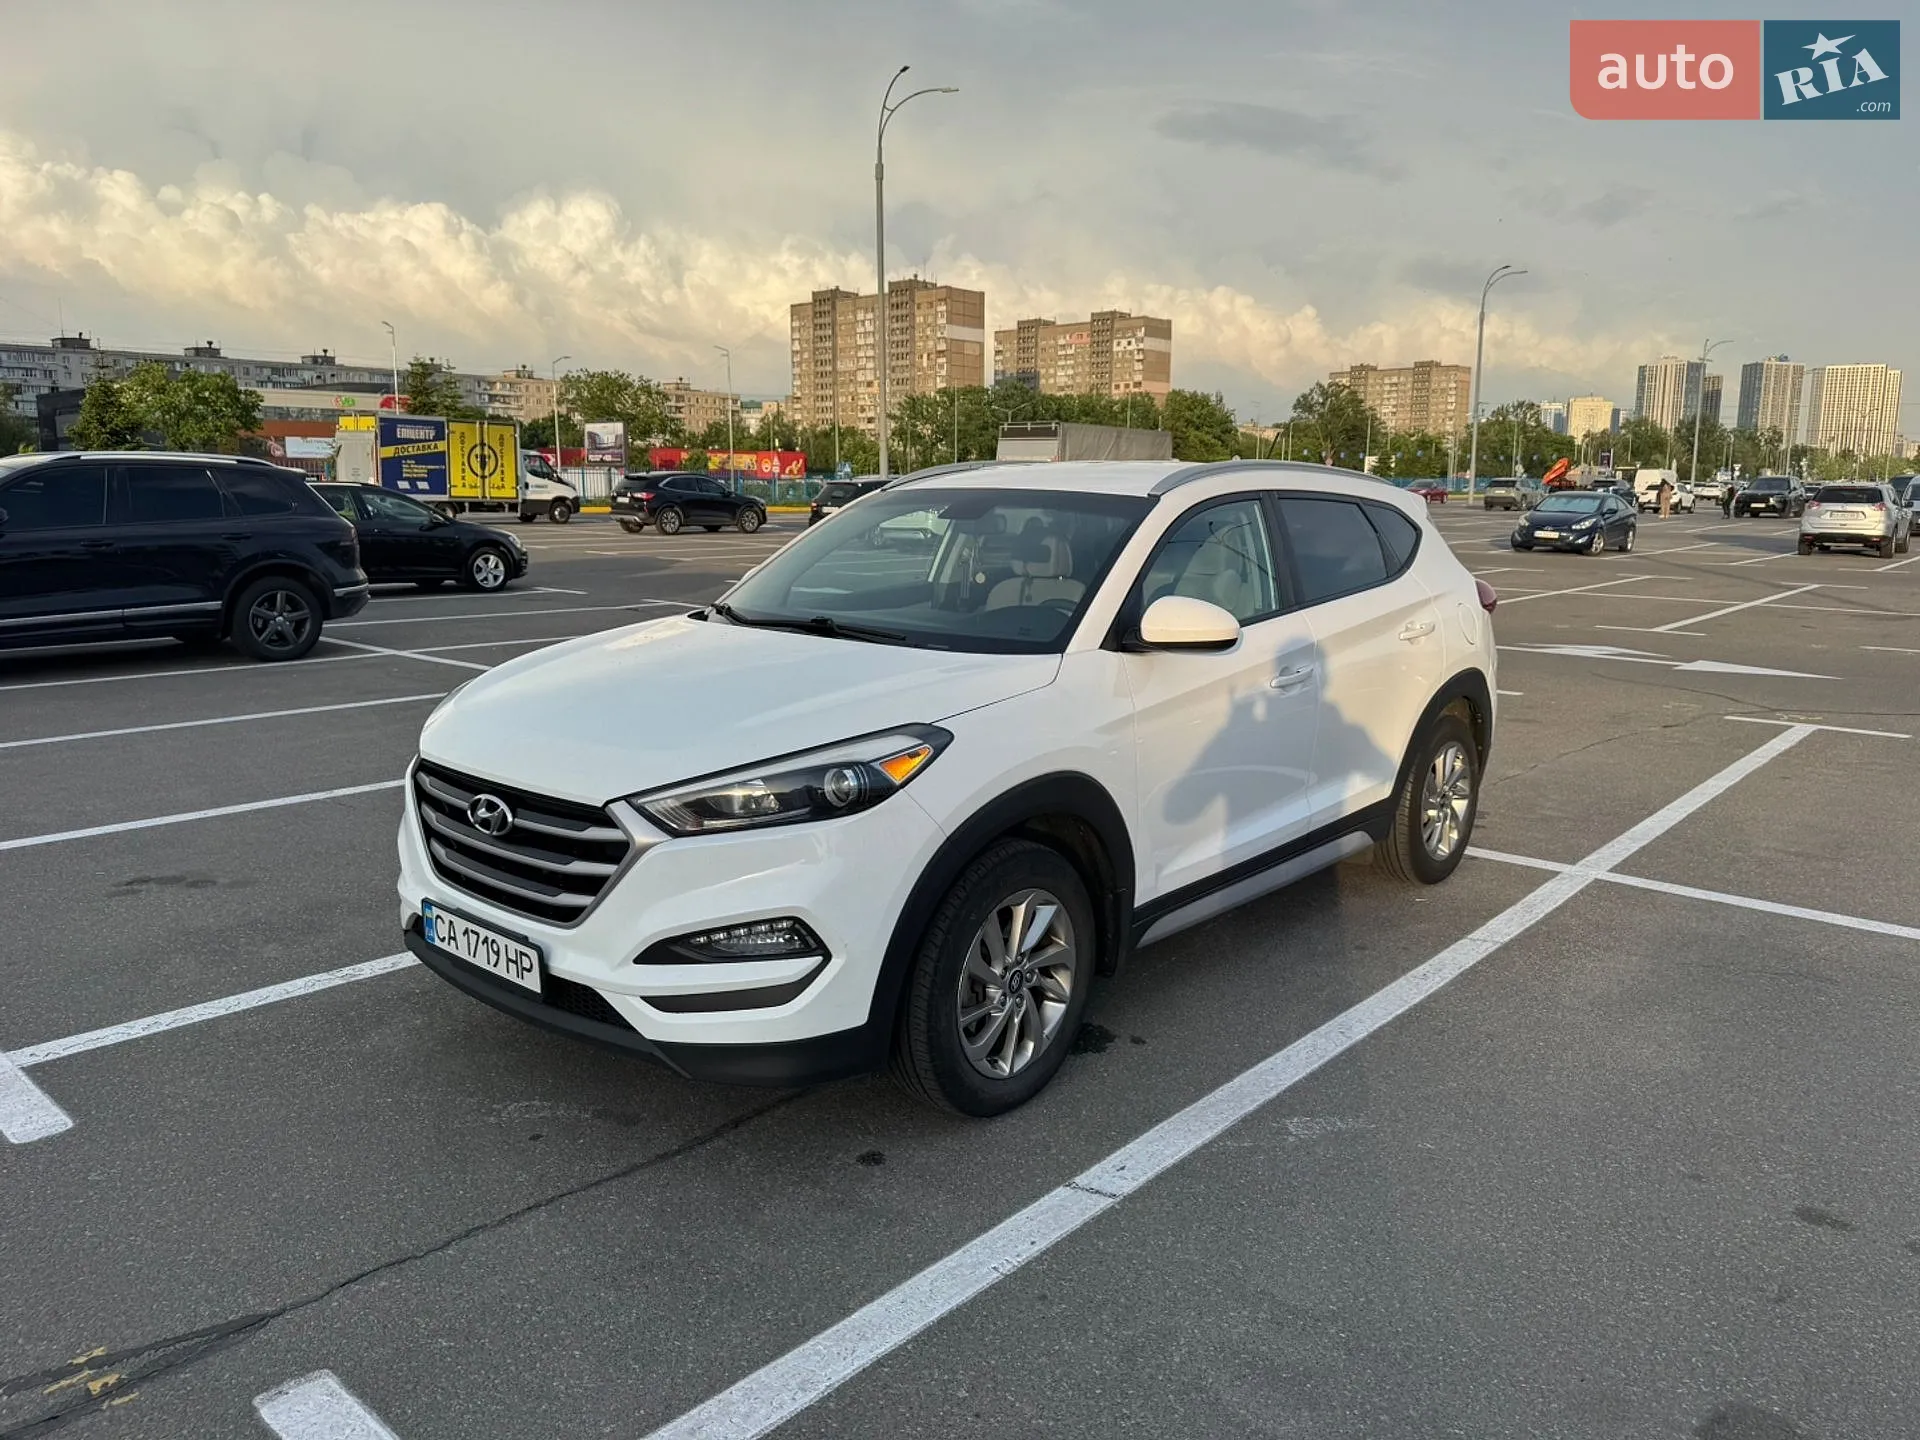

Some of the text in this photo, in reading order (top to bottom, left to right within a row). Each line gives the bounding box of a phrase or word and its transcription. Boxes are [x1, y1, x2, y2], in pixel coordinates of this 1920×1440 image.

[393, 442, 439, 457] ДОСТАВКА
[435, 914, 534, 980] CA 1719 HP
